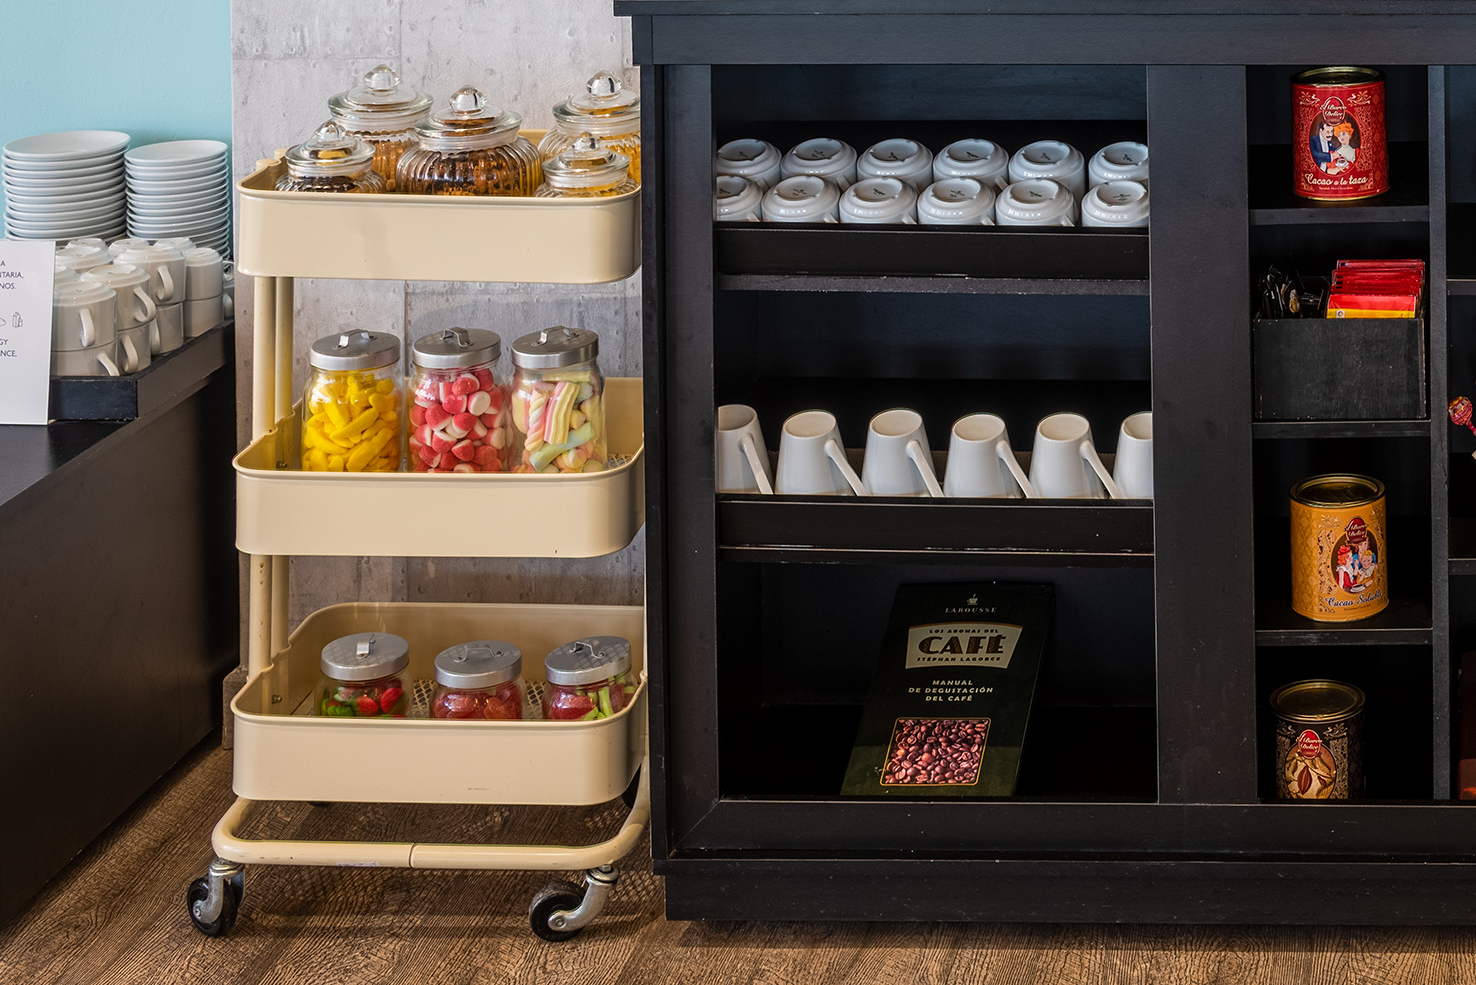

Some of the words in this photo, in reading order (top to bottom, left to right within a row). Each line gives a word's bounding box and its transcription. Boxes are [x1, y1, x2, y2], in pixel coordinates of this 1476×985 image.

[1304, 173, 1333, 185] Cacao
[1324, 597, 1355, 607] Cacao
[1356, 588, 1383, 605] Soluble
[918, 634, 1007, 655] CAFÉ
[925, 686, 994, 694] DEGUSTACIÓN
[947, 694, 973, 702] CAFÉ
